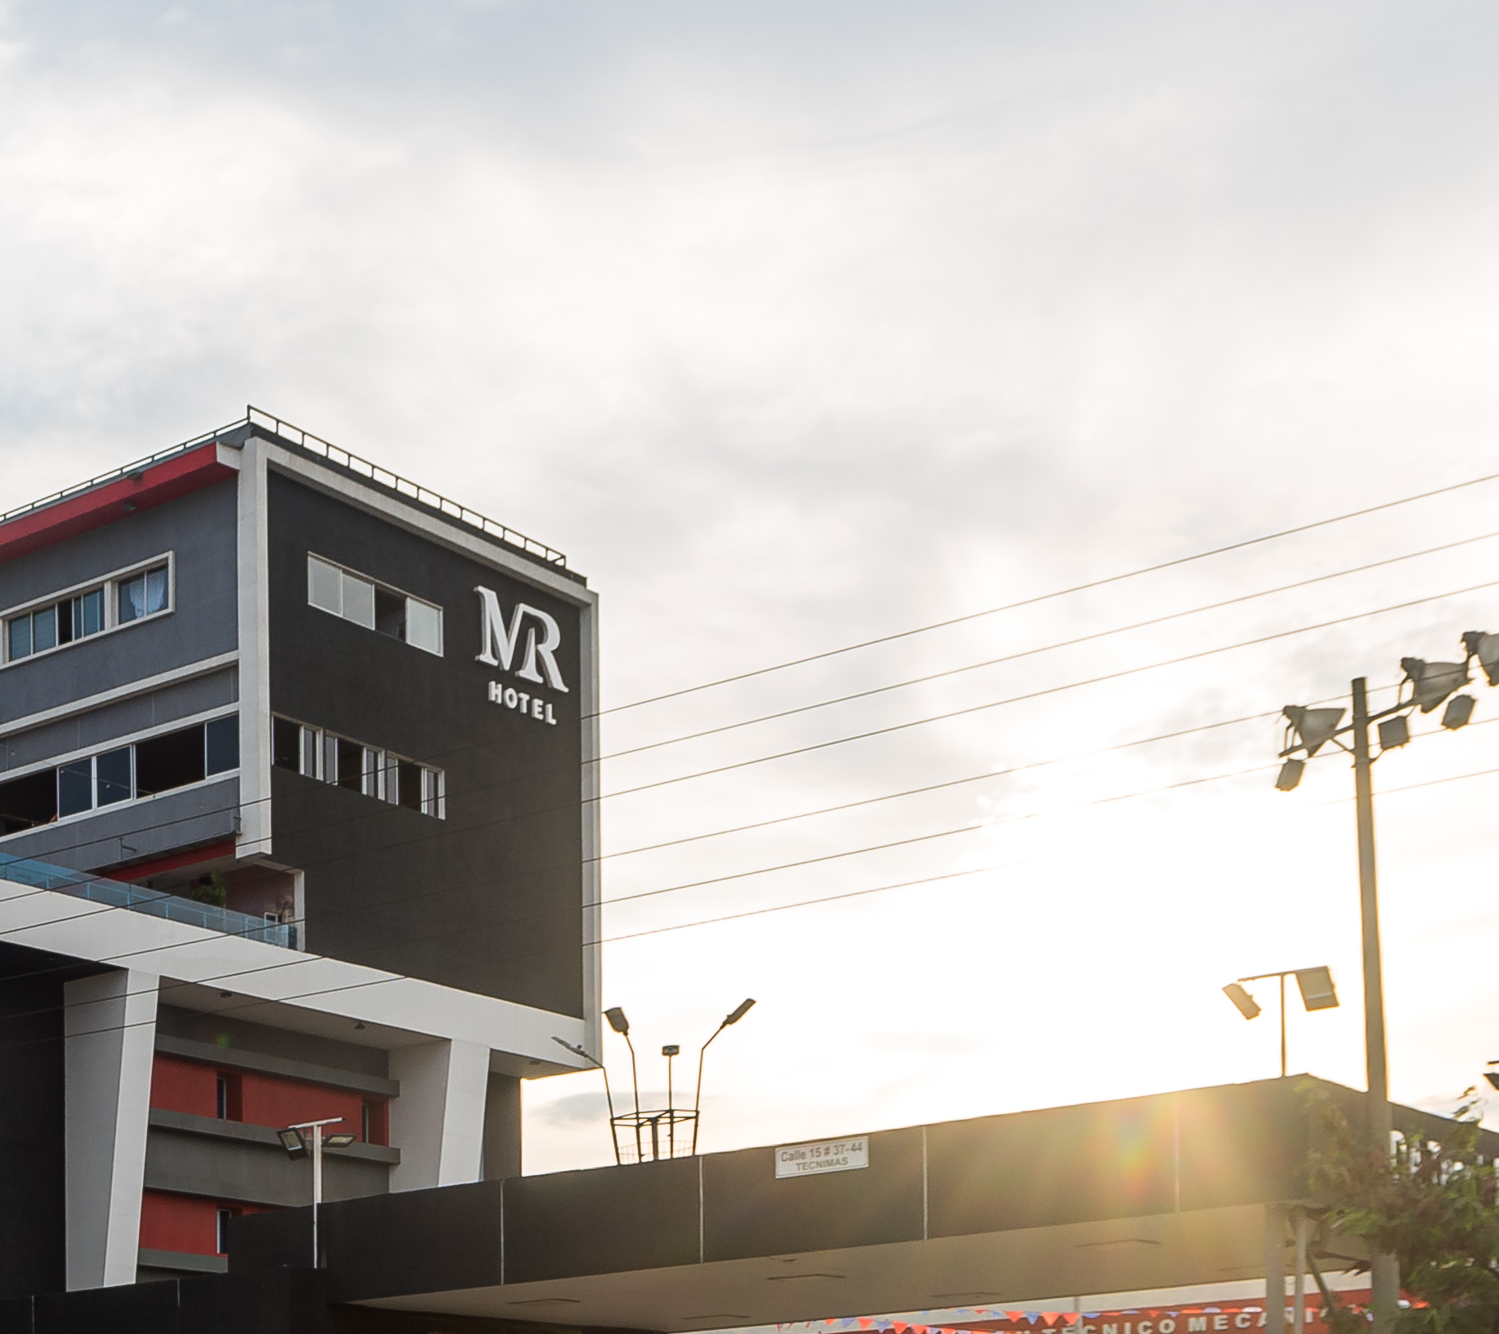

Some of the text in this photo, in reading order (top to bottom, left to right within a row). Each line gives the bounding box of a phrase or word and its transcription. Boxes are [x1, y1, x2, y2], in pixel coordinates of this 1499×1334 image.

[473, 585, 569, 693] MR
[488, 680, 557, 725] HOTEL
[781, 1142, 863, 1162] Calle 15 # 37-44
[795, 1157, 849, 1171] TECNIMAS
